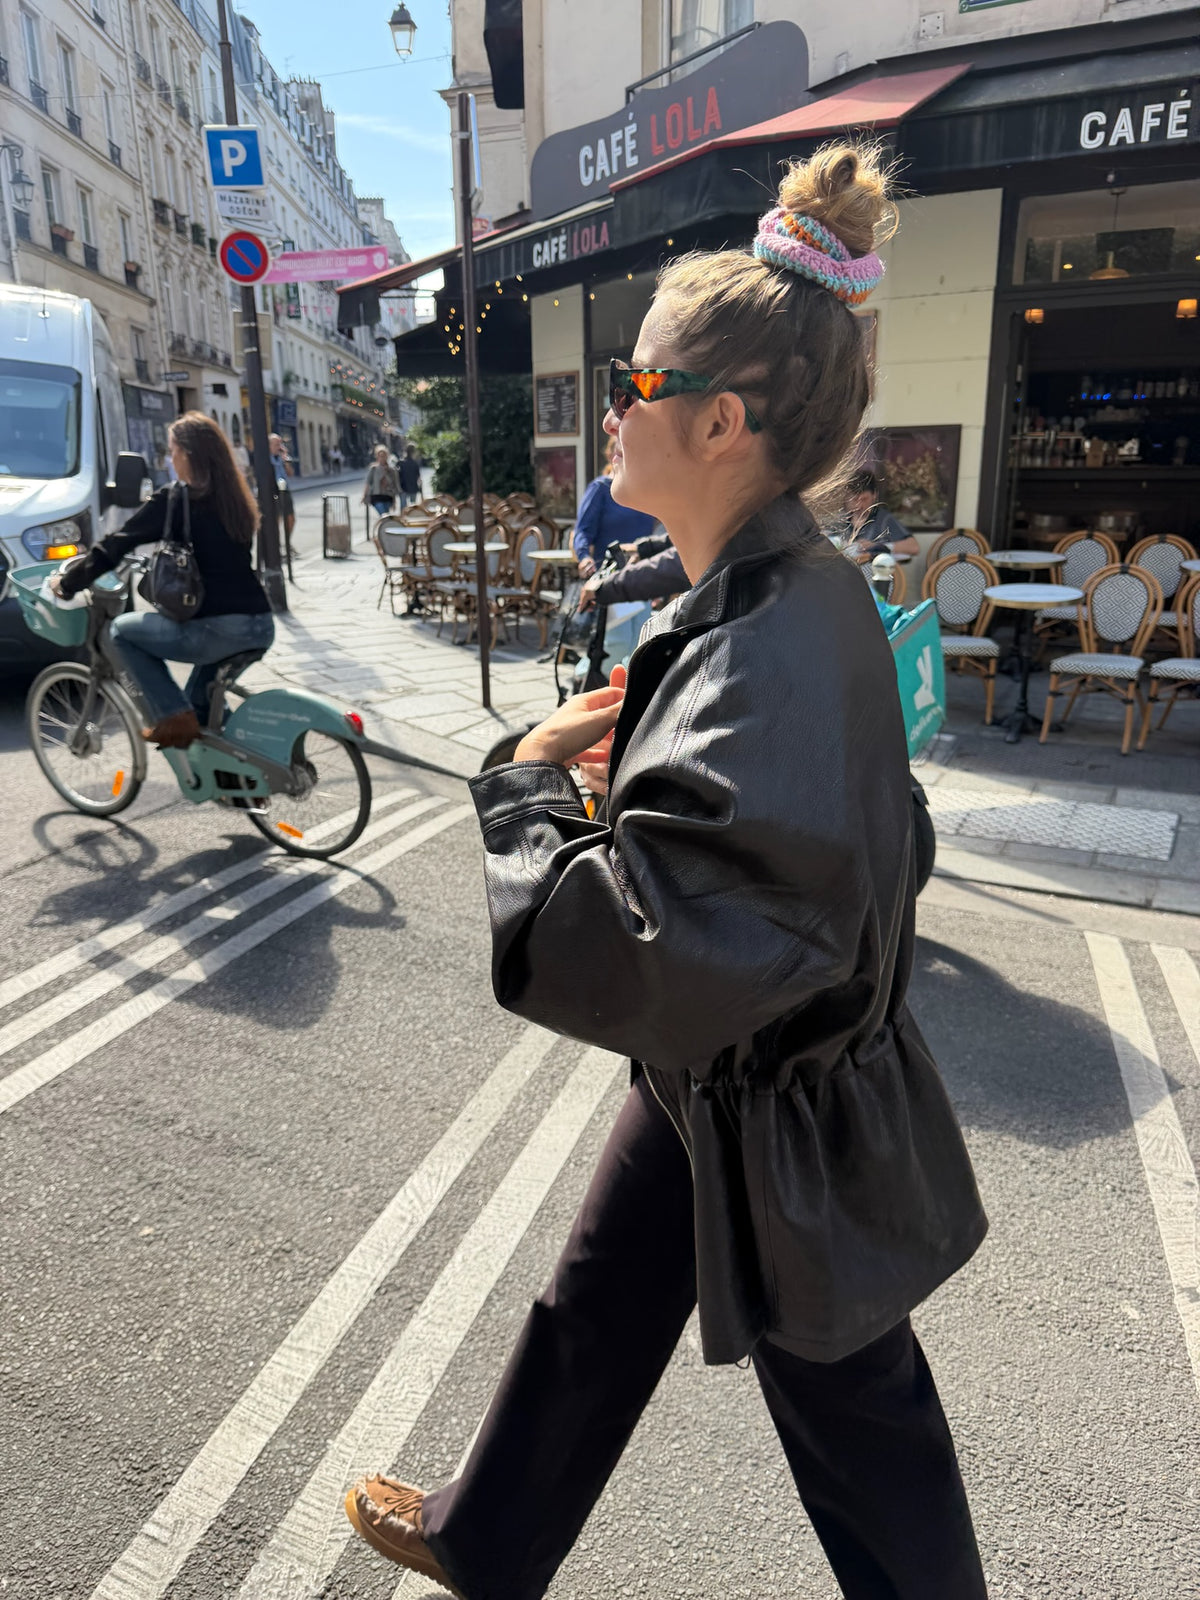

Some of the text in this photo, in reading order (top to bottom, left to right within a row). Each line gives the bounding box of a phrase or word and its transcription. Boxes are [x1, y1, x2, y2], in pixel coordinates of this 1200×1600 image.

[579, 86, 722, 187] CAFÉ LOLA
[1080, 89, 1192, 149] CAFÉ
[220, 139, 247, 177] P
[219, 194, 267, 207] MAZARINE
[532, 220, 610, 268] CAFÉ LOLA
